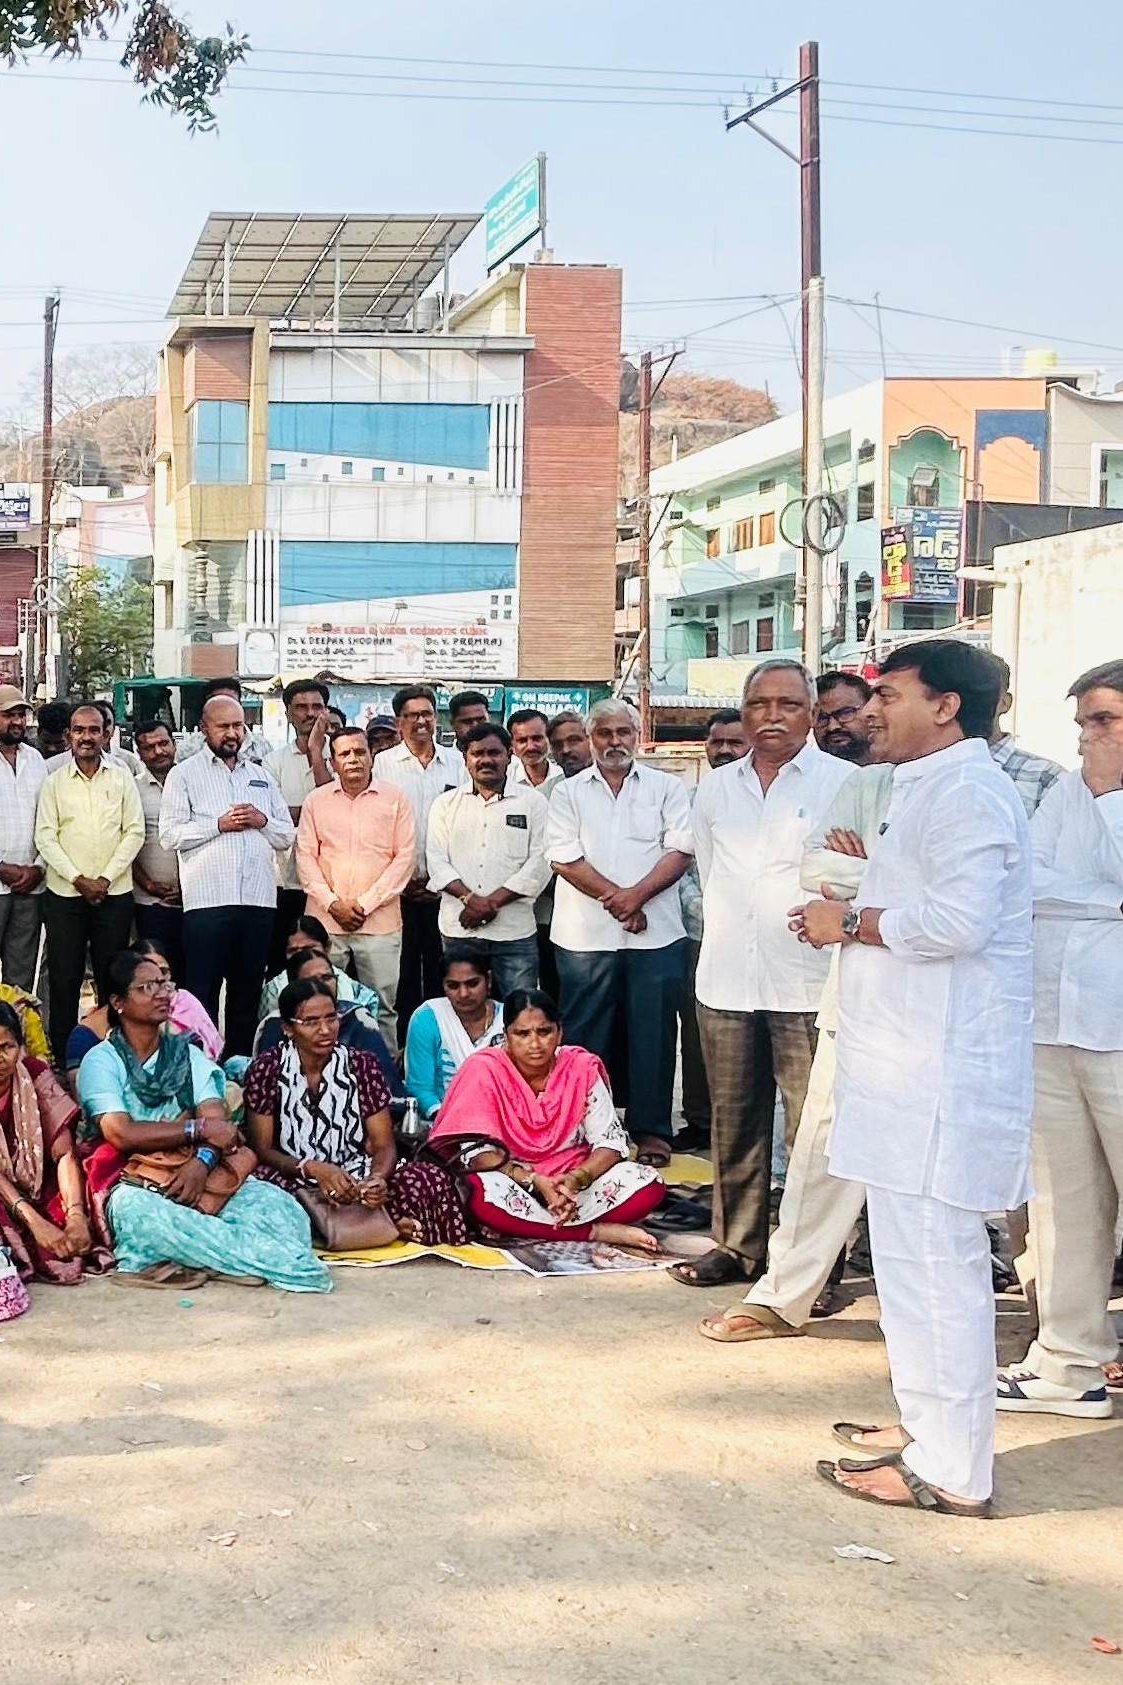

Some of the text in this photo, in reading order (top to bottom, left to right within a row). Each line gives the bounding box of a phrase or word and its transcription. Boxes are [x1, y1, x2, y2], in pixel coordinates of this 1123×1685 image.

[309, 637, 344, 645] DEEPAK
[453, 637, 503, 647] PREMRAJ
[537, 693, 572, 702] DEEPAK
